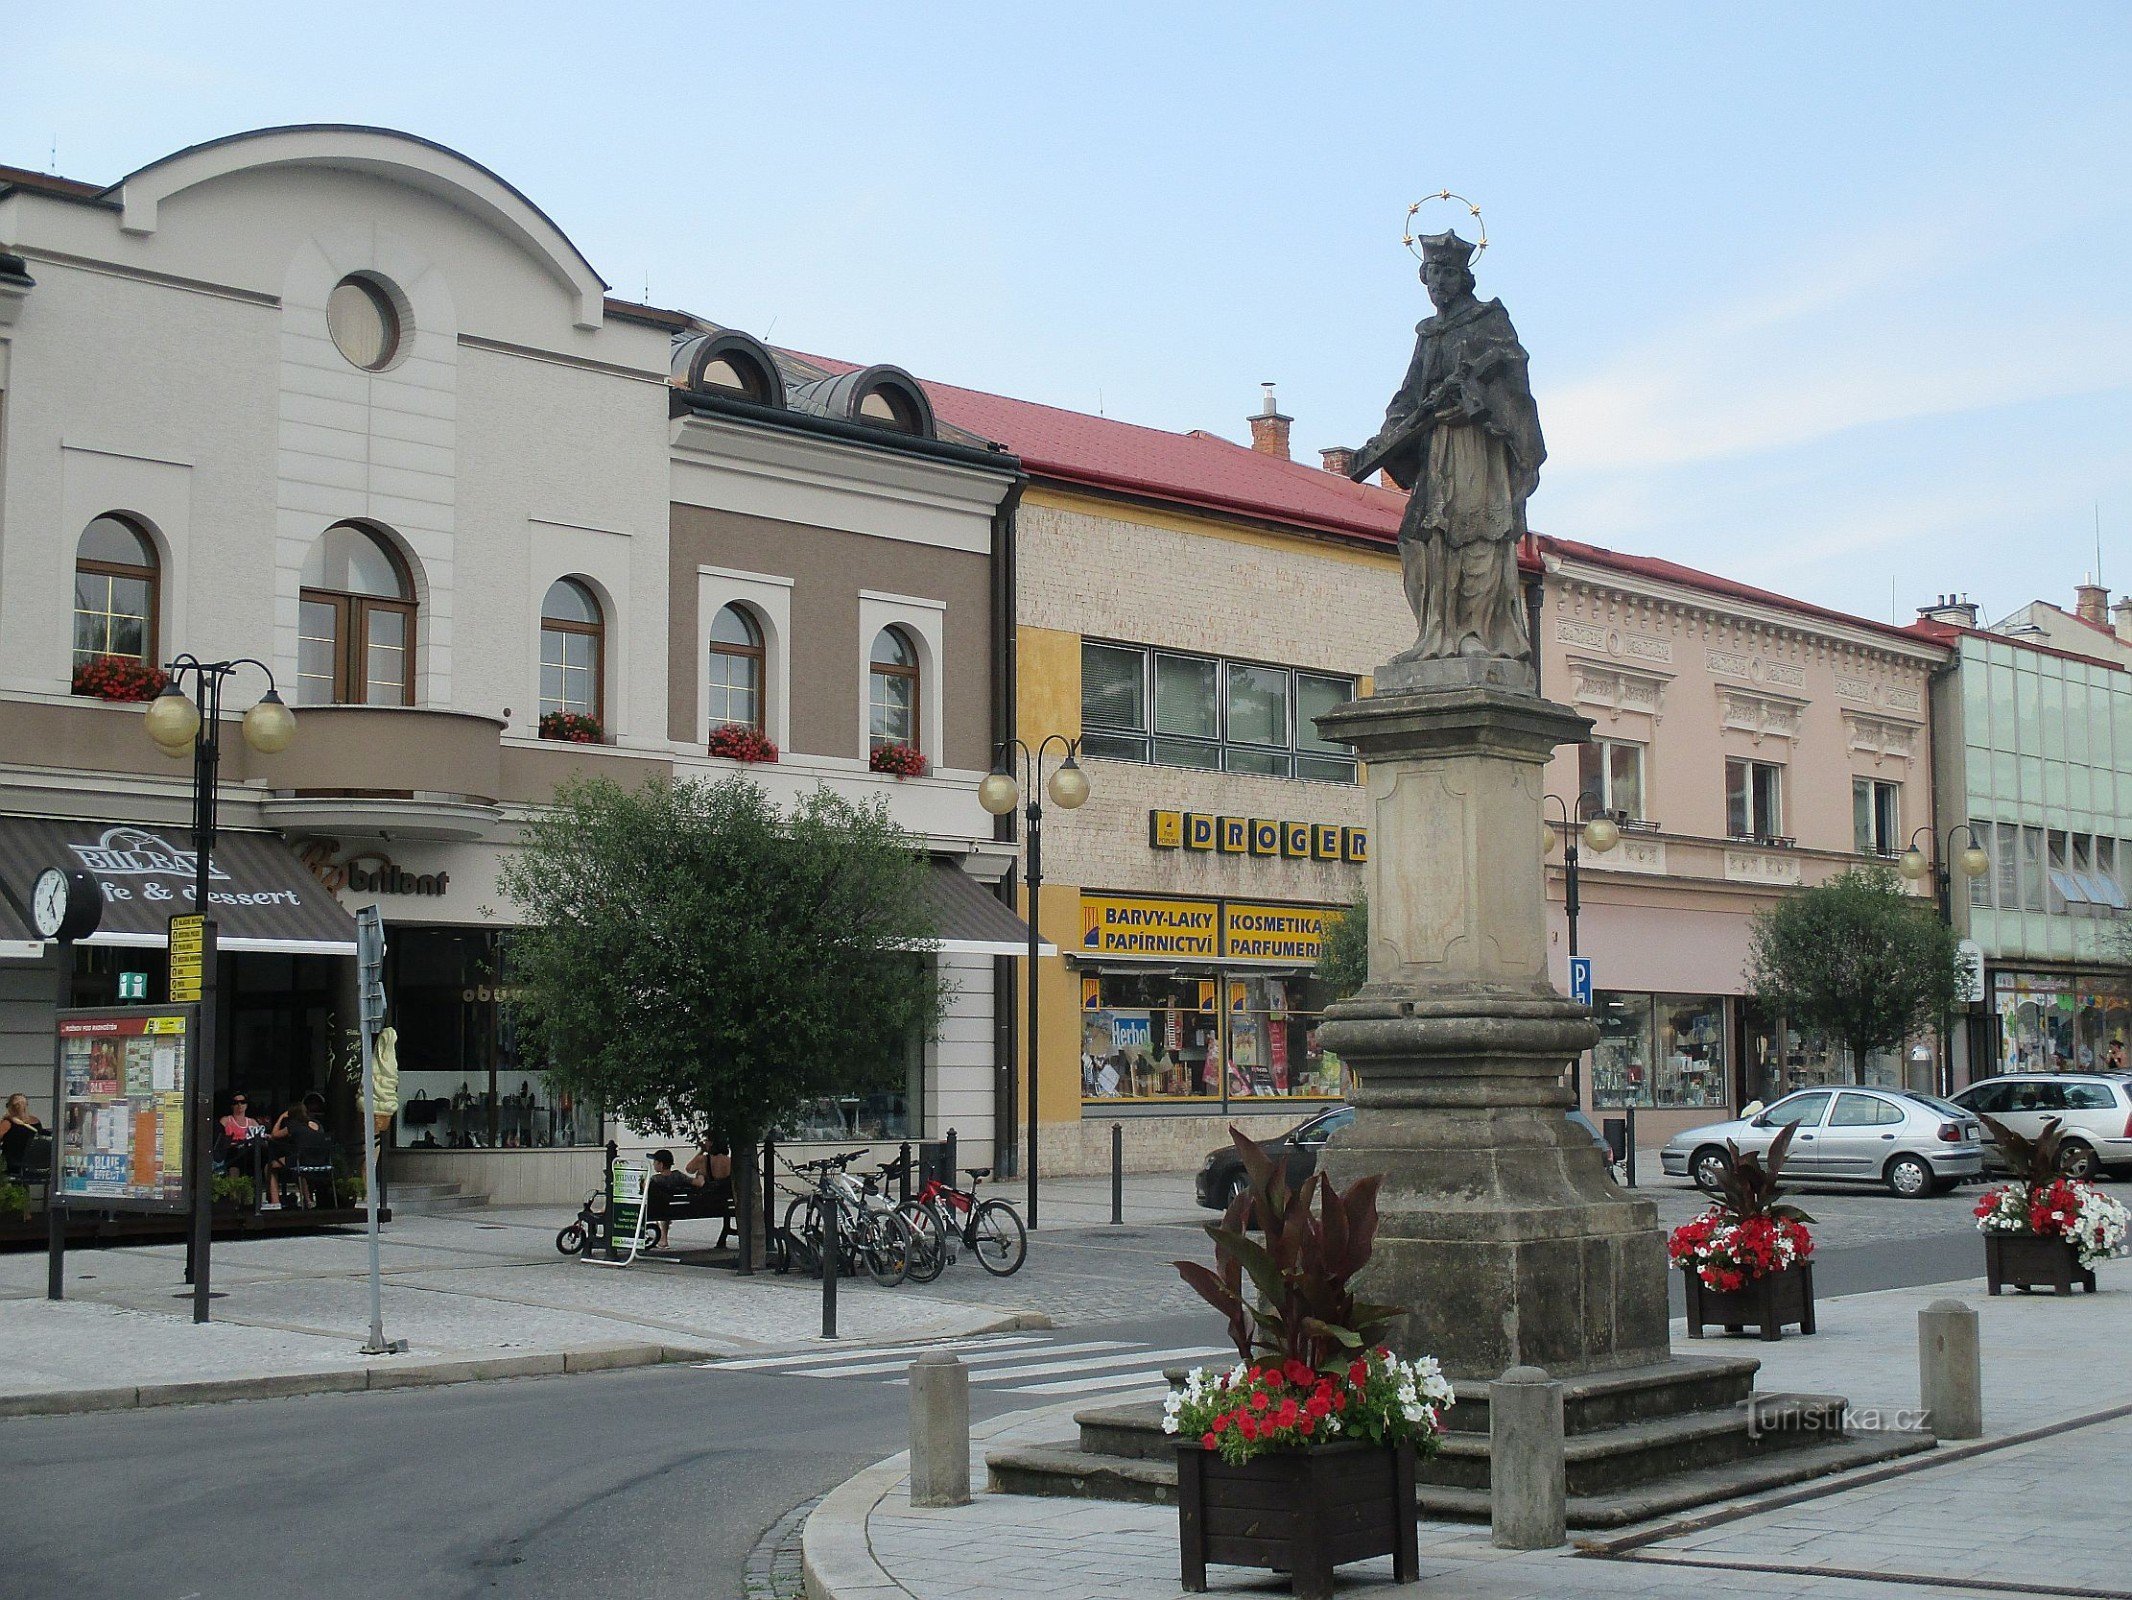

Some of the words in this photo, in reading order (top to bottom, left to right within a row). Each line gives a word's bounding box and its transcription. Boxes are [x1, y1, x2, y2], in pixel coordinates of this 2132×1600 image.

[1195, 820, 1367, 856] DROGER
[349, 862, 449, 896] brilant
[144, 882, 173, 900] &
[182, 884, 301, 906] dessert
[1105, 907, 1213, 929] BARVY-LAKY
[1229, 913, 1323, 934] KOSMETIKA
[1105, 930, 1213, 953] PAPÍRNICTVÍ
[1575, 963, 1586, 992] P
